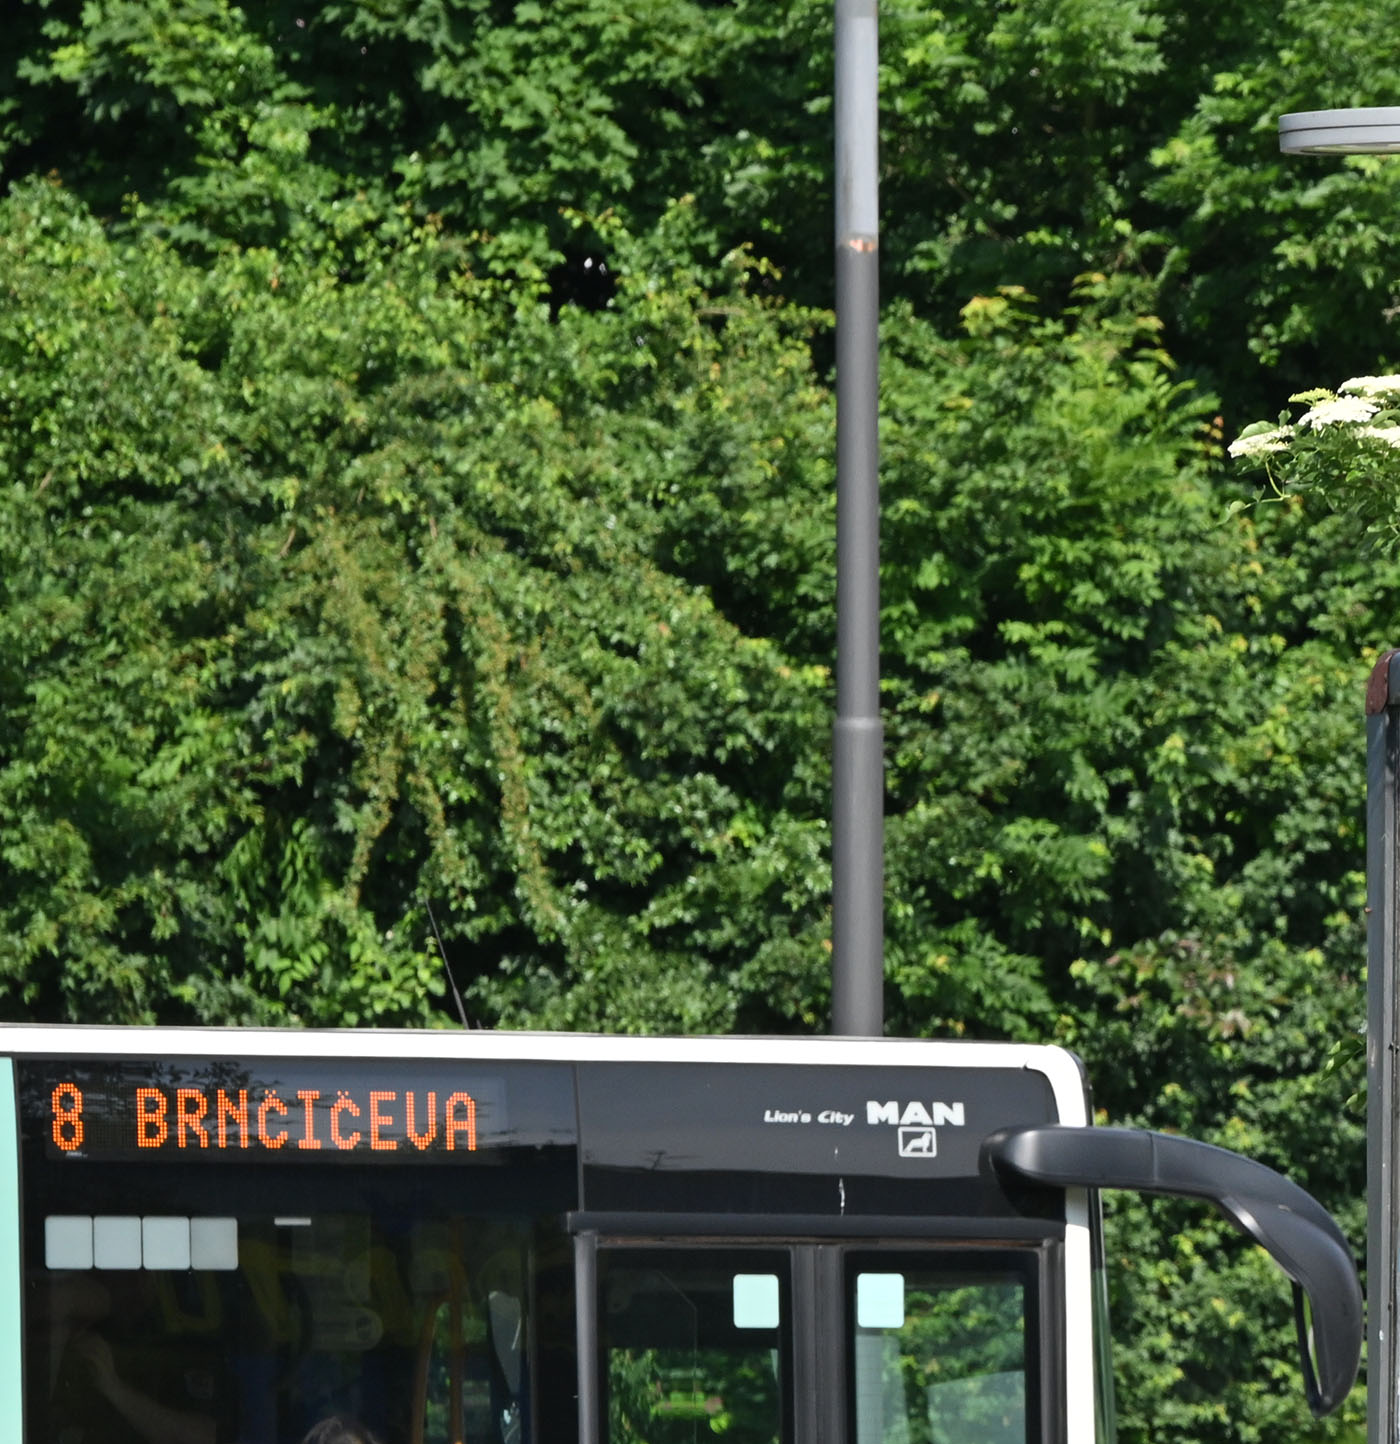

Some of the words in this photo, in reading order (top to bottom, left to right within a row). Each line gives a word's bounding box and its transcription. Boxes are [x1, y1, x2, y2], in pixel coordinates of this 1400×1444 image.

[51, 1083, 84, 1151] 8
[136, 1087, 477, 1151] BRNČIČEVA
[763, 1109, 812, 1124] Lion's
[817, 1110, 855, 1127] City
[866, 1100, 966, 1127] MAN
